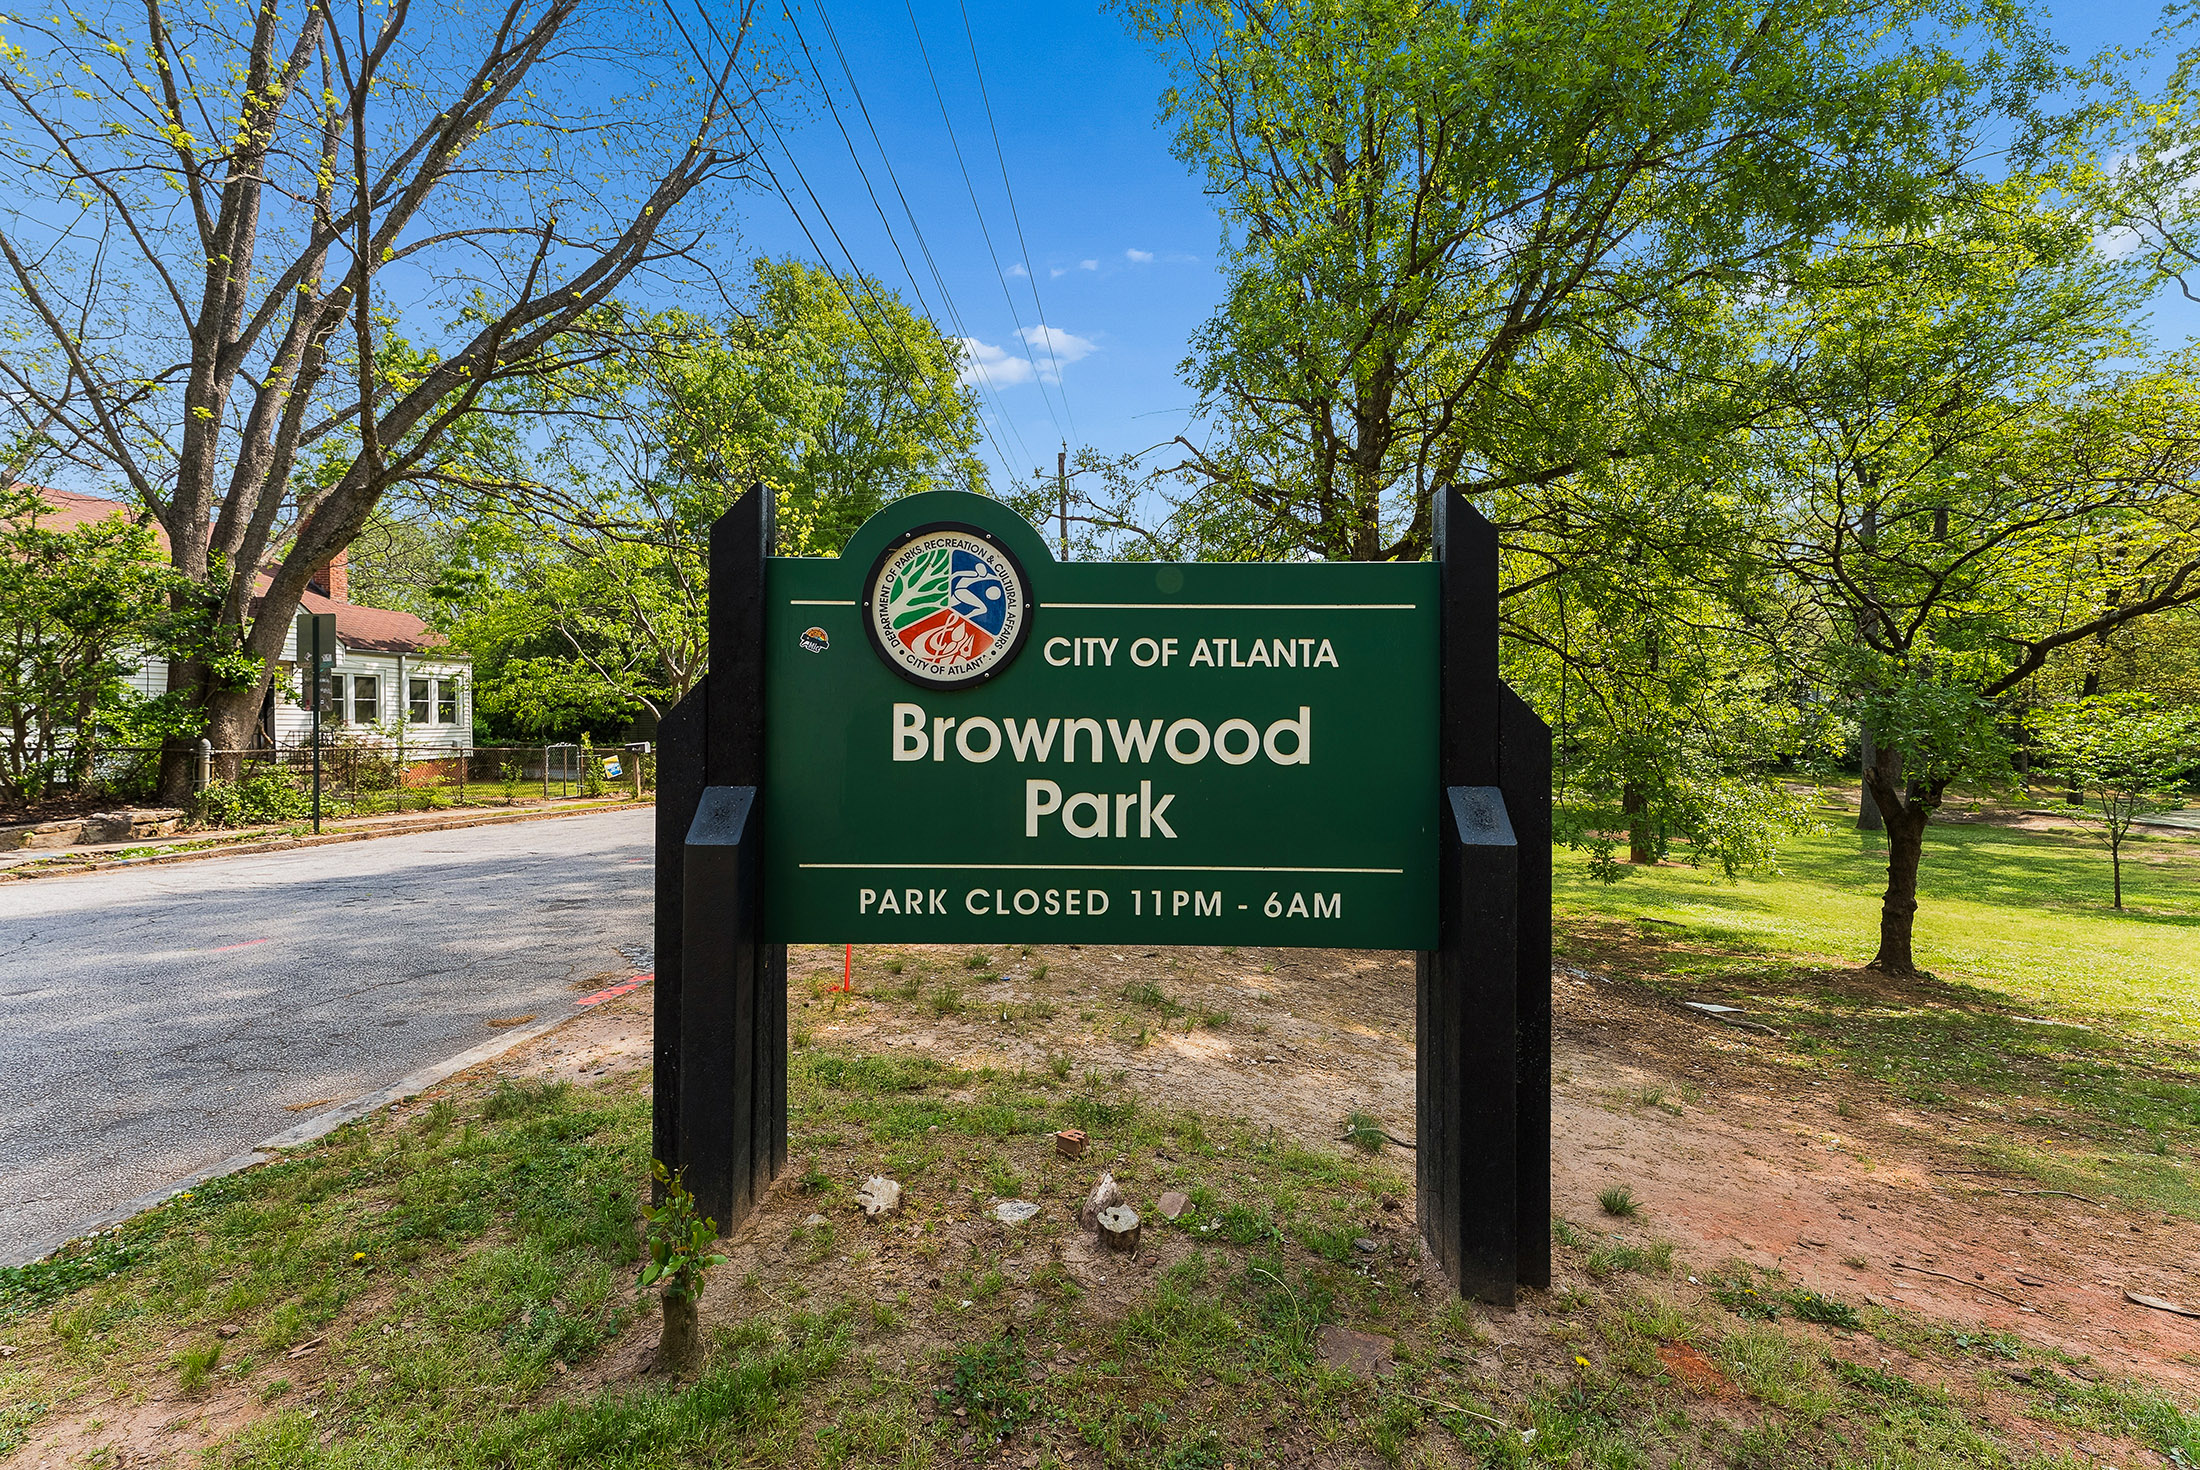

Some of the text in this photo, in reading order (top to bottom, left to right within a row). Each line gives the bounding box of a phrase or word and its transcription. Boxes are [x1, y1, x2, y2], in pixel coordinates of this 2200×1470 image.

[924, 538, 988, 559] RECREATION
[986, 554, 995, 565] &
[885, 568, 898, 582] OF
[994, 563, 1017, 610] CULTURAL
[879, 585, 901, 648] DEPARTMENT
[995, 612, 1017, 650] AFFAIRS
[906, 653, 992, 676] CITY OF ATLANT
[1044, 637, 1340, 668] CITY OF ATLANTA
[892, 702, 1311, 766] Brownwood
[1025, 779, 1178, 839] Park
[860, 888, 948, 915] PARK
[965, 888, 1110, 916] CLOSED
[1131, 890, 1222, 917] 11PM
[1263, 891, 1342, 919] 6AM
